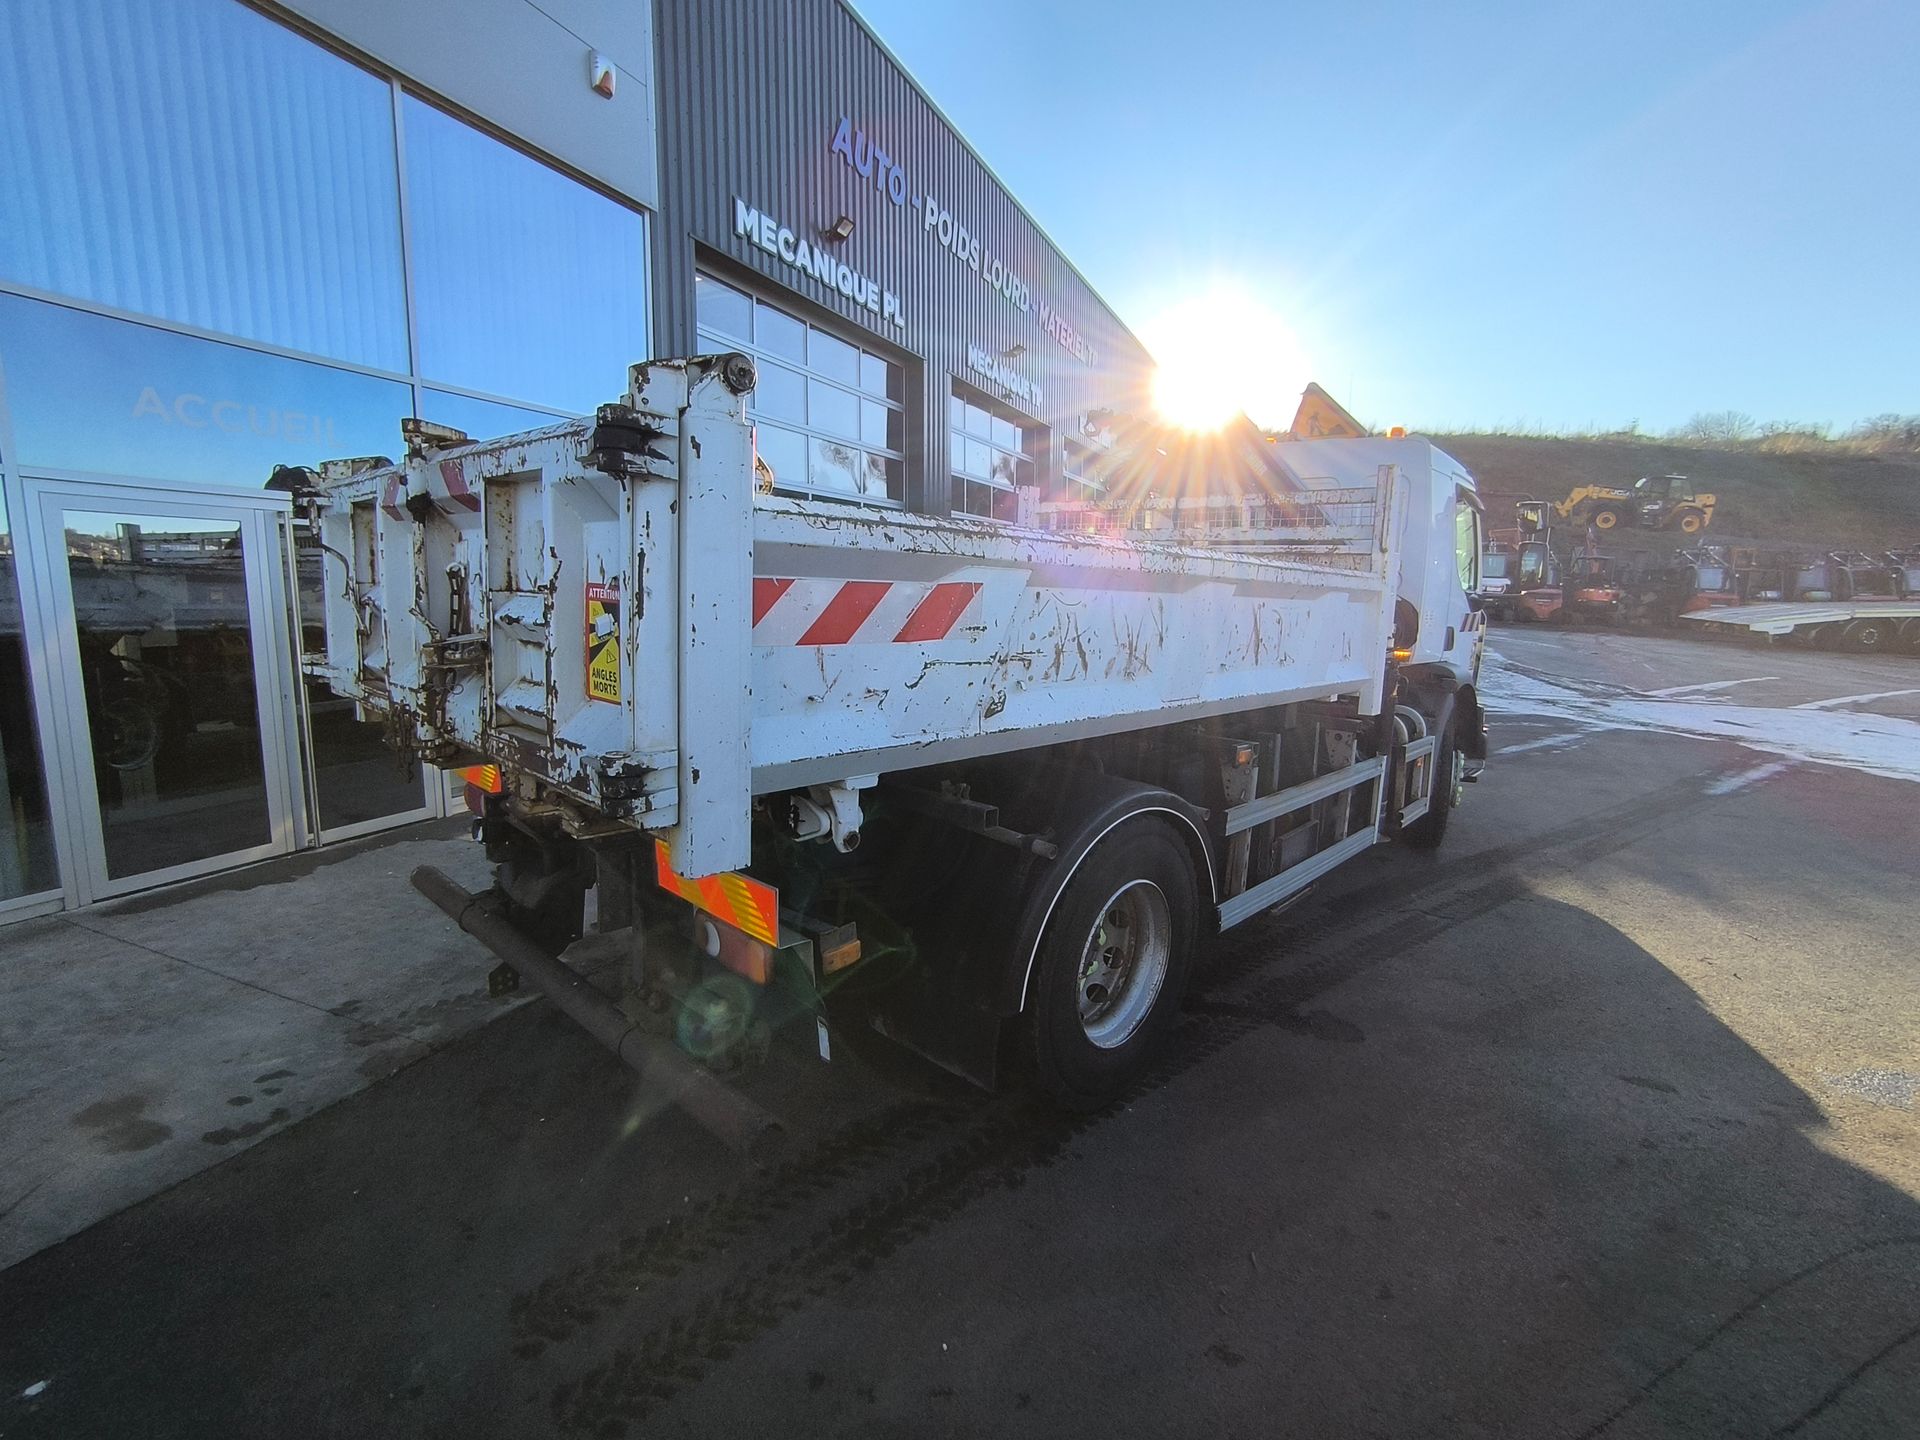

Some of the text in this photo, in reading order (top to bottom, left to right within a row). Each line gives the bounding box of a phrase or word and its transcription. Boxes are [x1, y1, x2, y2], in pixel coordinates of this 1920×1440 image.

[734, 195, 905, 328] MECANIQUE PL
[831, 116, 907, 206] AUTO
[924, 195, 981, 272] POIDS
[981, 248, 1029, 313] LOURD
[1038, 301, 1086, 361] MATERIEL
[967, 343, 1030, 400] MECANIQUE
[131, 386, 347, 449] ACCUEIL
[589, 588, 620, 600] ATTENTION
[592, 668, 617, 683] ANGLES
[593, 682, 617, 696] MORTS
